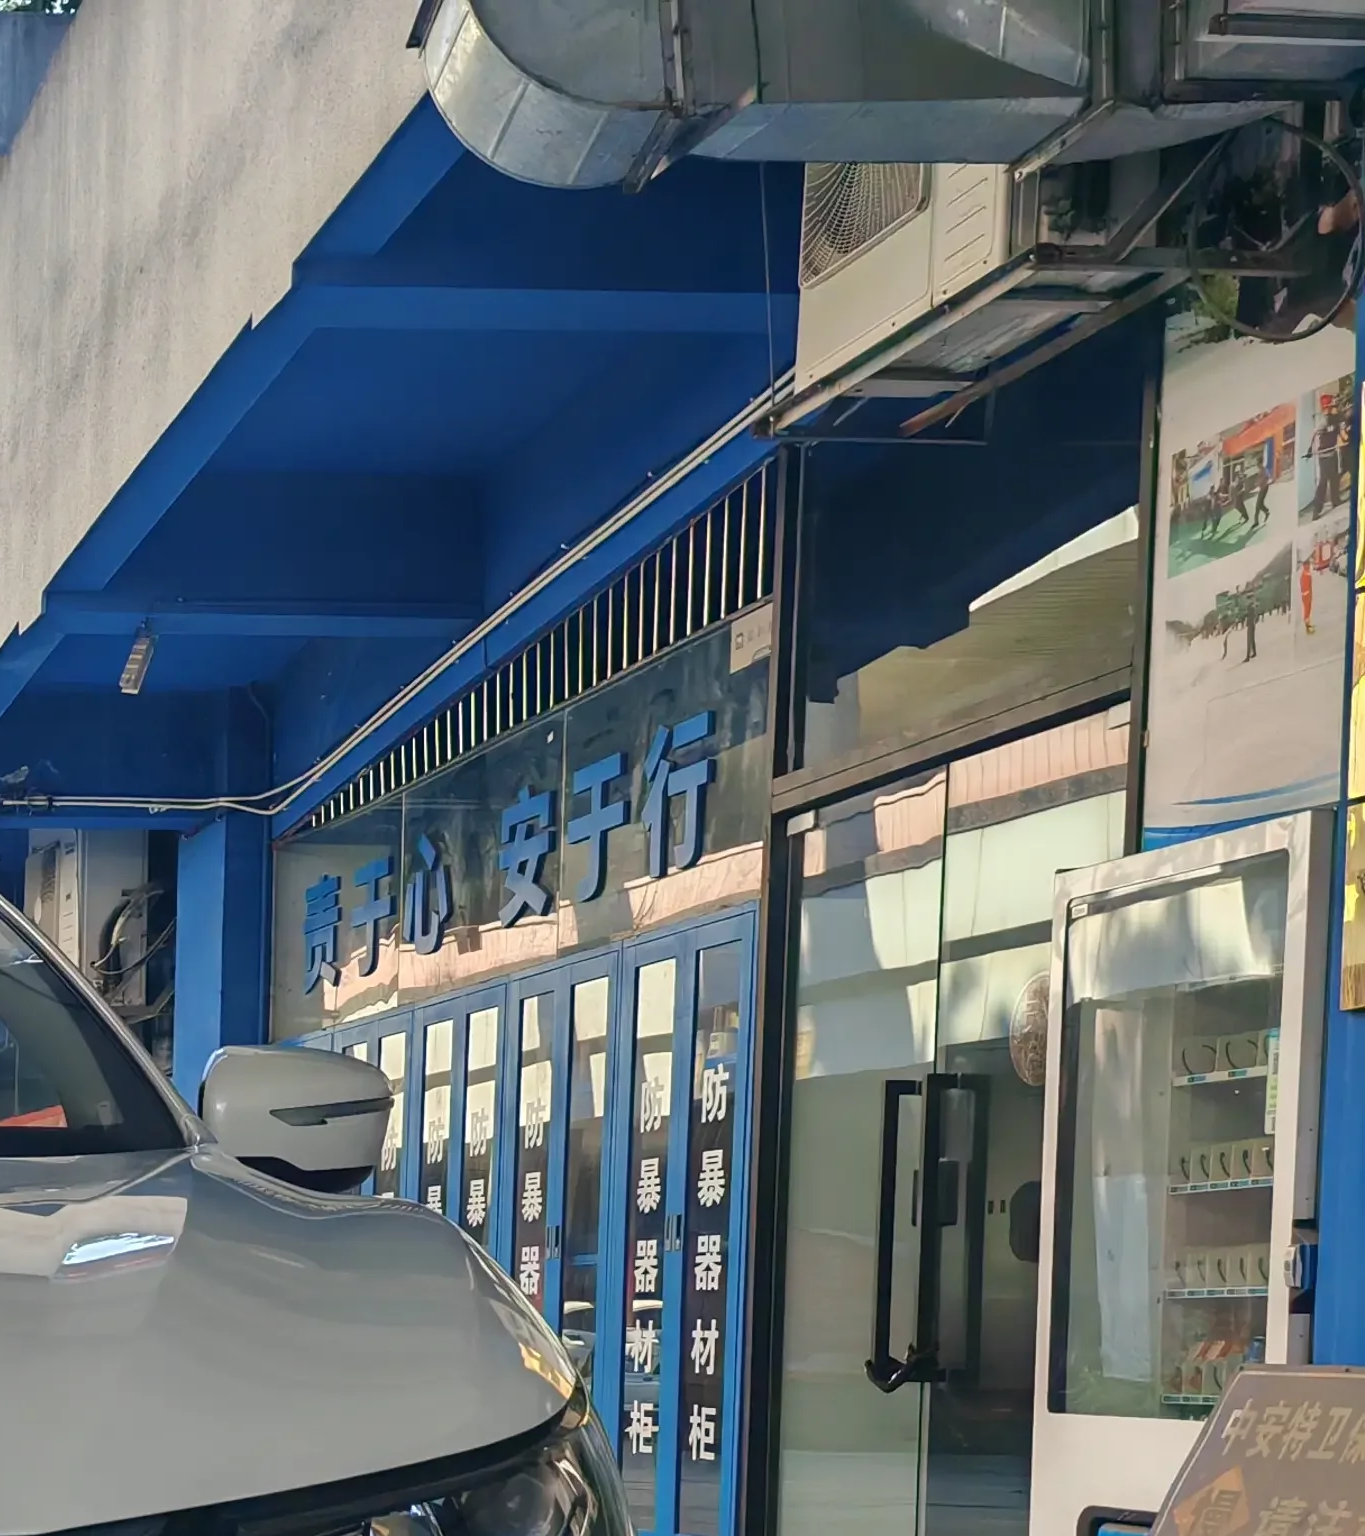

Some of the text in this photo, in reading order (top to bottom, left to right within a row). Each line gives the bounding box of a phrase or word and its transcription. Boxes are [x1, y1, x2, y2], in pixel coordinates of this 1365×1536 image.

[498, 710, 716, 930] 安于行
[519, 1097, 546, 1297] 防暴器
[627, 1078, 663, 1455] 防暴器材柜
[688, 1063, 730, 1461] 防暴器材柜
